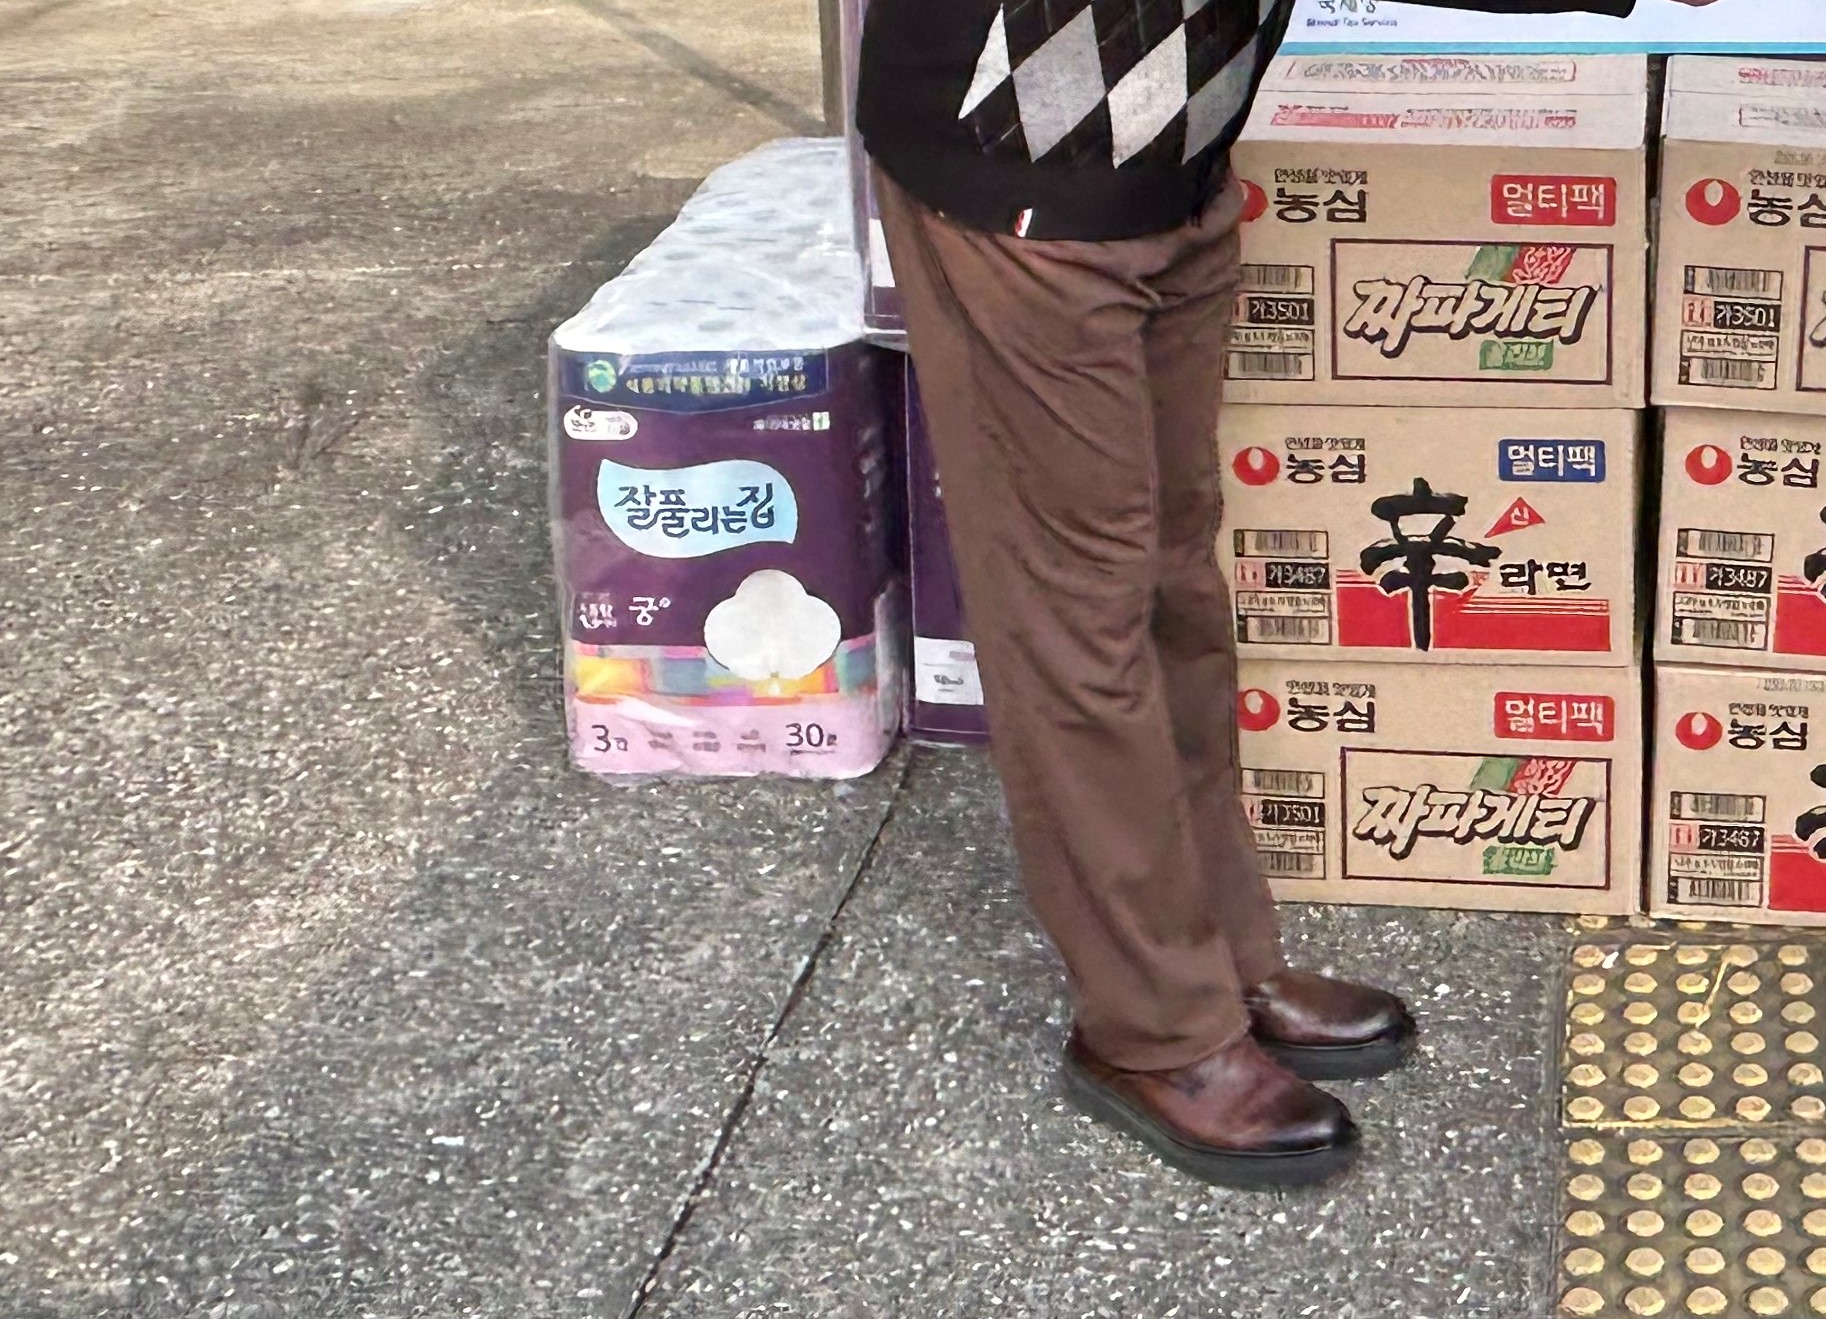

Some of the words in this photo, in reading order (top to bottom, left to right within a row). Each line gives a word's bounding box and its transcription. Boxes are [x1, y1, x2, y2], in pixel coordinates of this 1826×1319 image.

[1274, 186, 1368, 224] 농심
[1502, 182, 1606, 220] 멀티팩
[1343, 275, 1598, 358] 짜파게티
[1286, 453, 1367, 484] 농심
[1507, 445, 1596, 477] 멀티팩
[1737, 454, 1819, 488] 농심
[614, 483, 775, 538] 잘풀리는집
[1360, 477, 1502, 651] 辛
[1499, 559, 1591, 595] 라면
[1287, 696, 1376, 733] 농심
[1505, 698, 1604, 736] 멀티팩
[1728, 718, 1808, 751] 농심
[1352, 784, 1597, 860] 짜파게티
